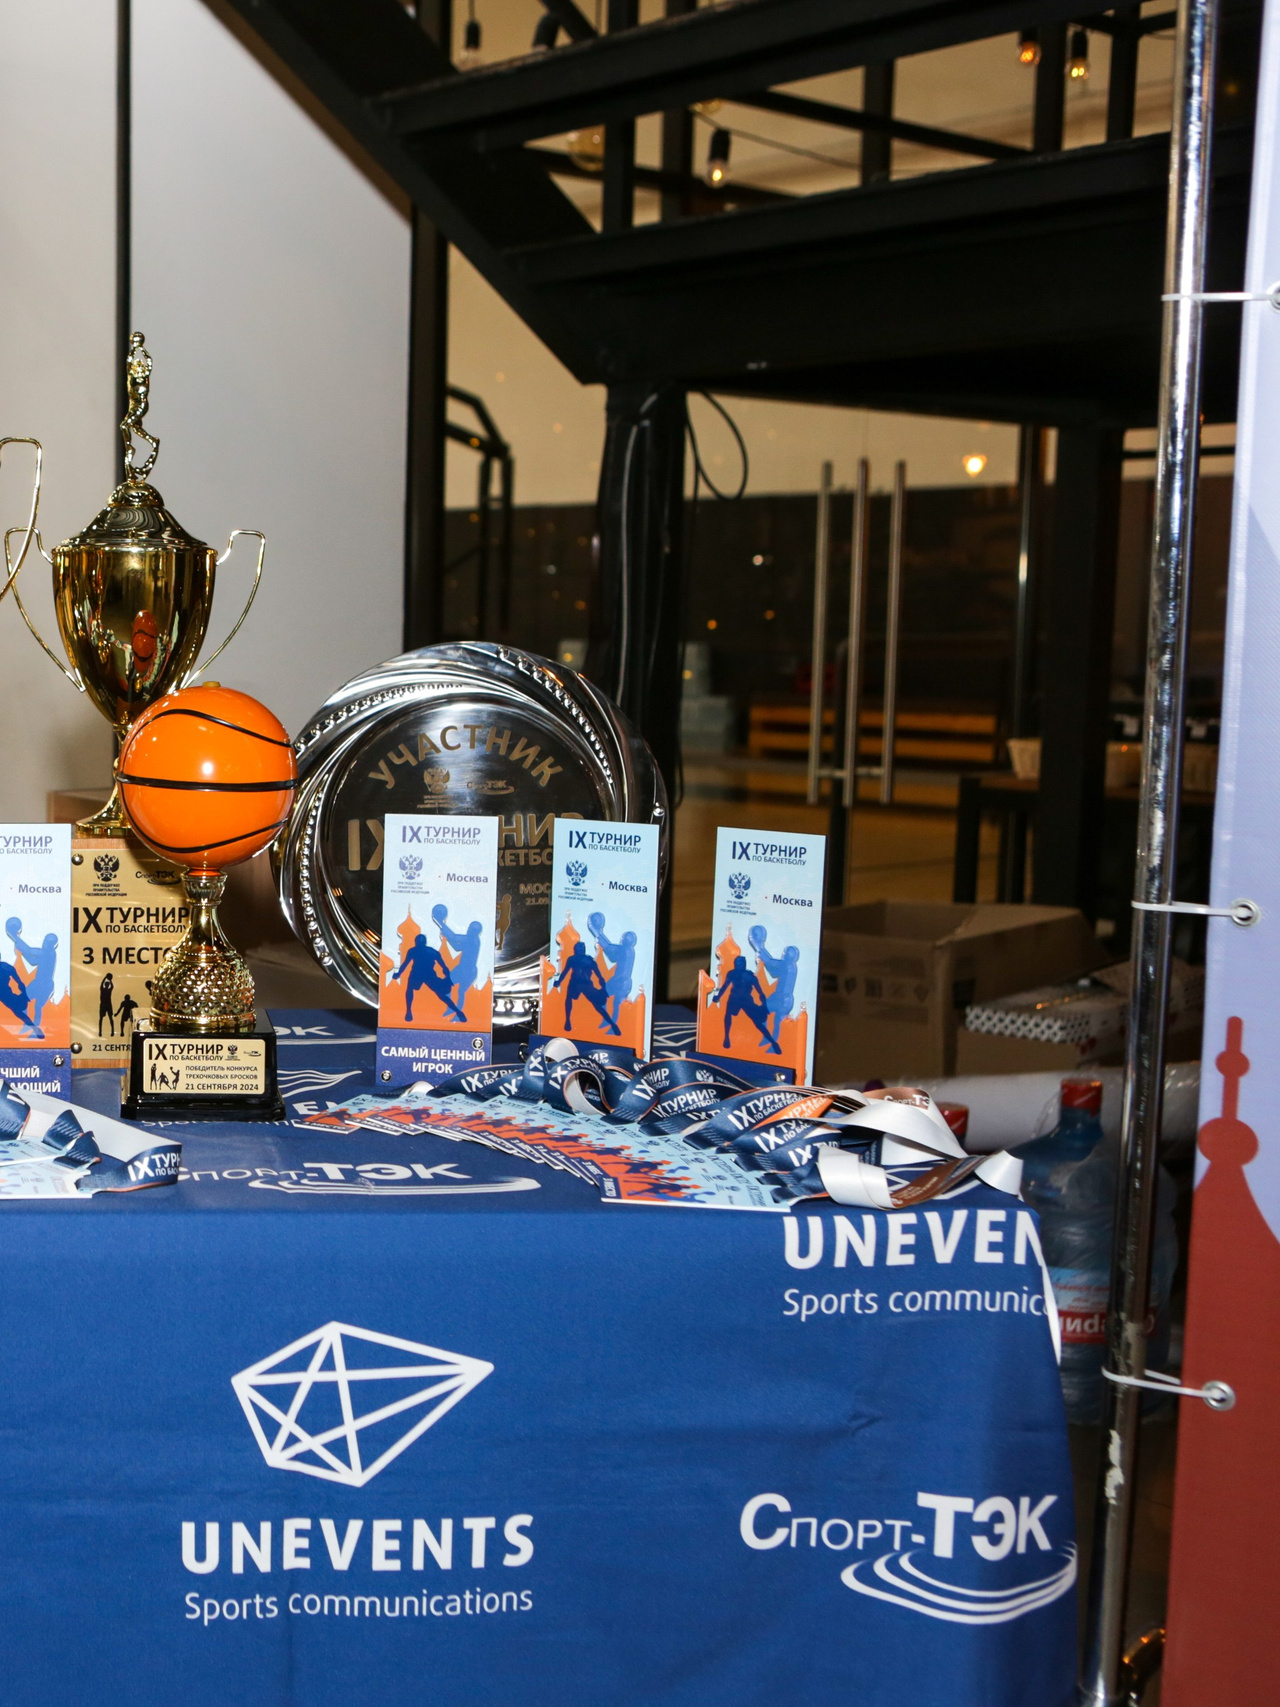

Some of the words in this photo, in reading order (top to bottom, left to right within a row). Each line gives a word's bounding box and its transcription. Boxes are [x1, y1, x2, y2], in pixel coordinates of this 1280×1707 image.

[368, 724, 563, 790] УЧАСТНИК
[402, 826, 422, 844] IX
[424, 826, 480, 838] ТУРНИР
[569, 830, 587, 849] IX
[589, 831, 641, 846] ТУРНИР
[6, 847, 52, 855] БАСКЕТБОЛУ
[588, 842, 599, 850] ПО
[601, 843, 641, 853] БАСКЕТБОЛУ
[732, 841, 751, 861] IX
[753, 843, 807, 859] ТУРНИР
[763, 856, 806, 866] БАСКЕТБОЛУ
[446, 873, 489, 883] Москва
[608, 880, 648, 893] Москва
[18, 884, 62, 894] Москва
[772, 894, 813, 907] Москва
[73, 907, 102, 933] IX
[106, 907, 189, 923] ТУРНИР
[105, 925, 120, 933] ПО
[82, 947, 94, 964] 3
[104, 1044, 132, 1052] СЕНТЯ
[148, 1044, 168, 1060] IX
[170, 1044, 224, 1055] ТУРНИР
[381, 1044, 428, 1058] САМЫЙ
[431, 1048, 485, 1062] ЦЕННЫЙ
[413, 1061, 453, 1074] ИГРОК
[529, 1057, 544, 1076] IX
[197, 1083, 238, 1091] СЕНТЯБРЯ
[461, 1073, 484, 1093] IX
[499, 1078, 518, 1096] IX
[549, 1066, 568, 1090] IX
[632, 1076, 656, 1100] IX
[662, 1089, 717, 1112] ТУРНИР
[727, 1108, 756, 1130] IX
[754, 1131, 785, 1153] IX
[783, 1129, 794, 1141] ПО
[788, 1144, 813, 1167] IX
[128, 1158, 152, 1182] IX
[155, 1168, 167, 1178] ПО
[782, 1288, 878, 1322] Sports
[181, 1514, 534, 1574] UNEVENTS
[184, 1592, 278, 1627] Sports
[288, 1587, 533, 1617] communications
